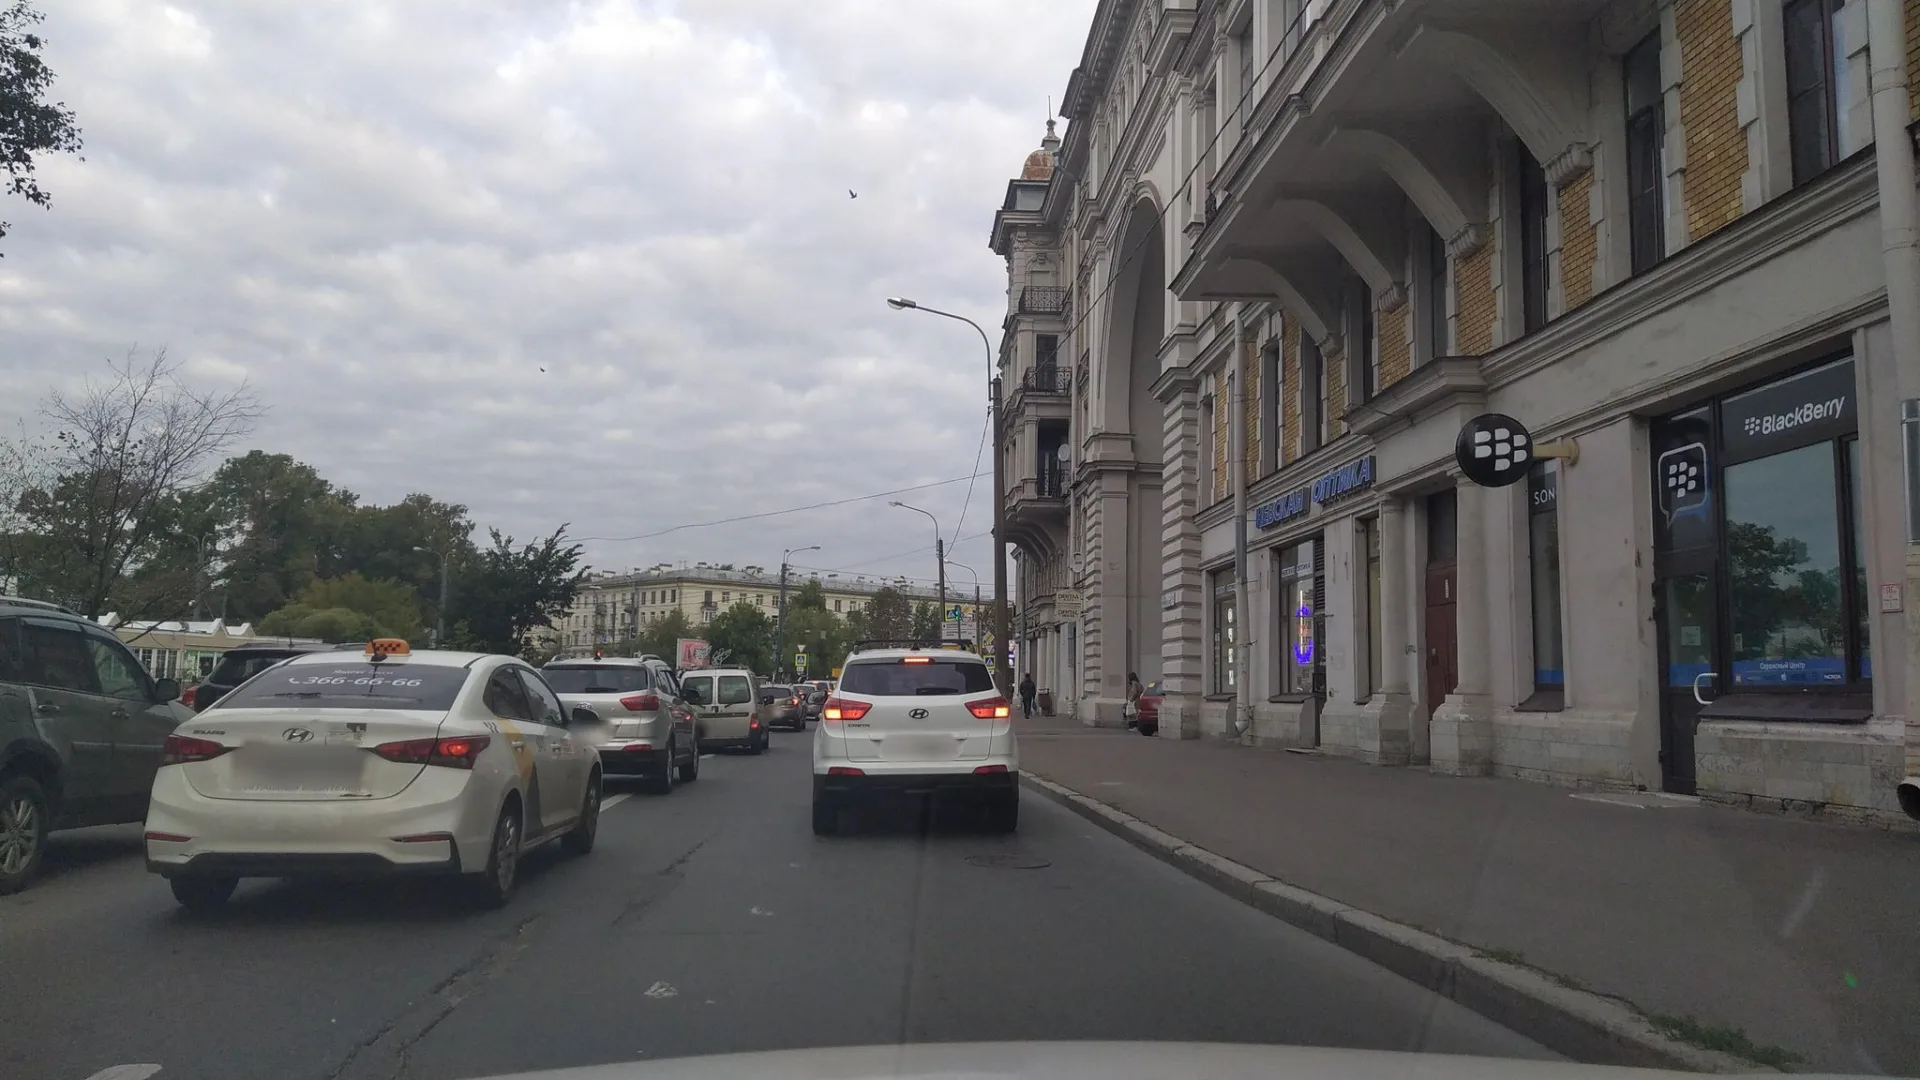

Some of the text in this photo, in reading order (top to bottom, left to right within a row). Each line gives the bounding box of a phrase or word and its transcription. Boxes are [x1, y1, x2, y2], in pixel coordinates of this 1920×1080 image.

[1761, 396, 1845, 435] BlackBerry
[1312, 455, 1370, 503] ОПТИКА
[302, 676, 422, 687] 366-66-66
